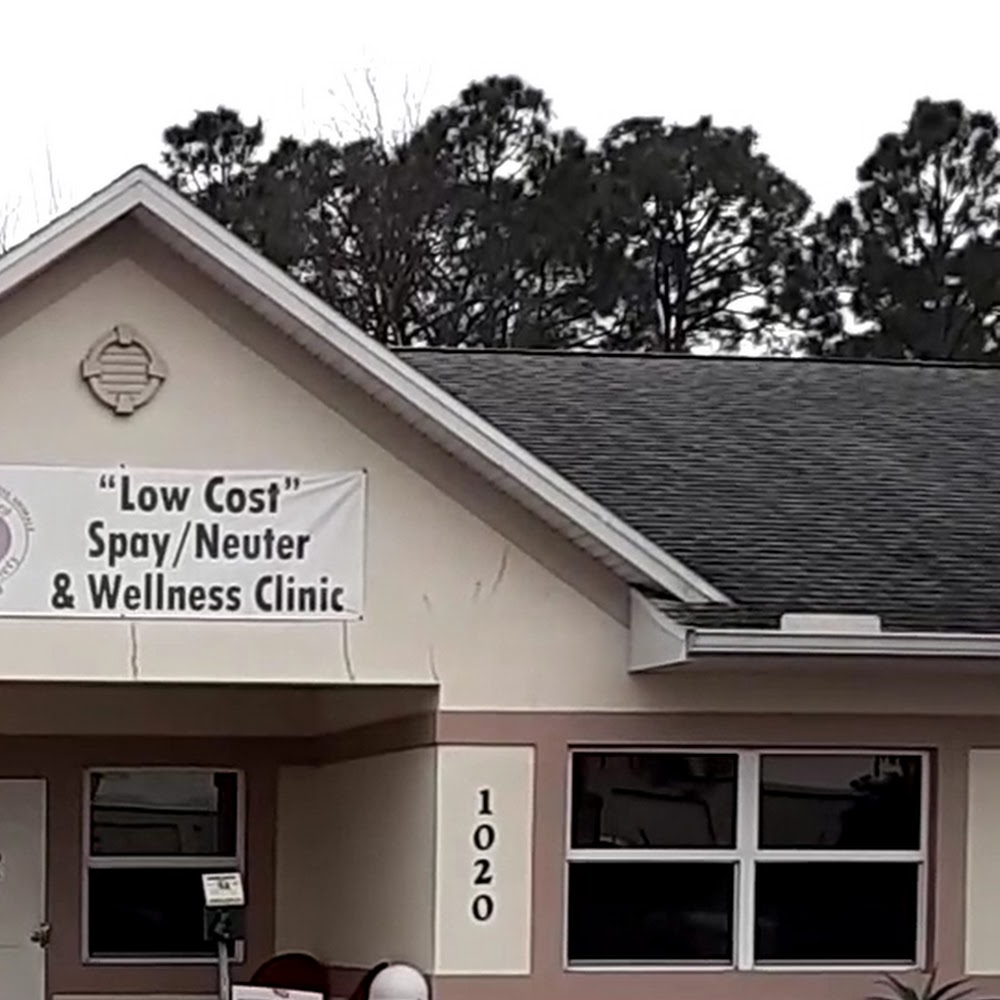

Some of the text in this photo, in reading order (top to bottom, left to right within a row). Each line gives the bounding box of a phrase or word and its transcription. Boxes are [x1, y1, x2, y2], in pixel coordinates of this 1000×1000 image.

[88, 520, 311, 568] Spay/Neuter
[51, 572, 345, 613] & Wellness Clinic
[471, 788, 496, 922] 1020
